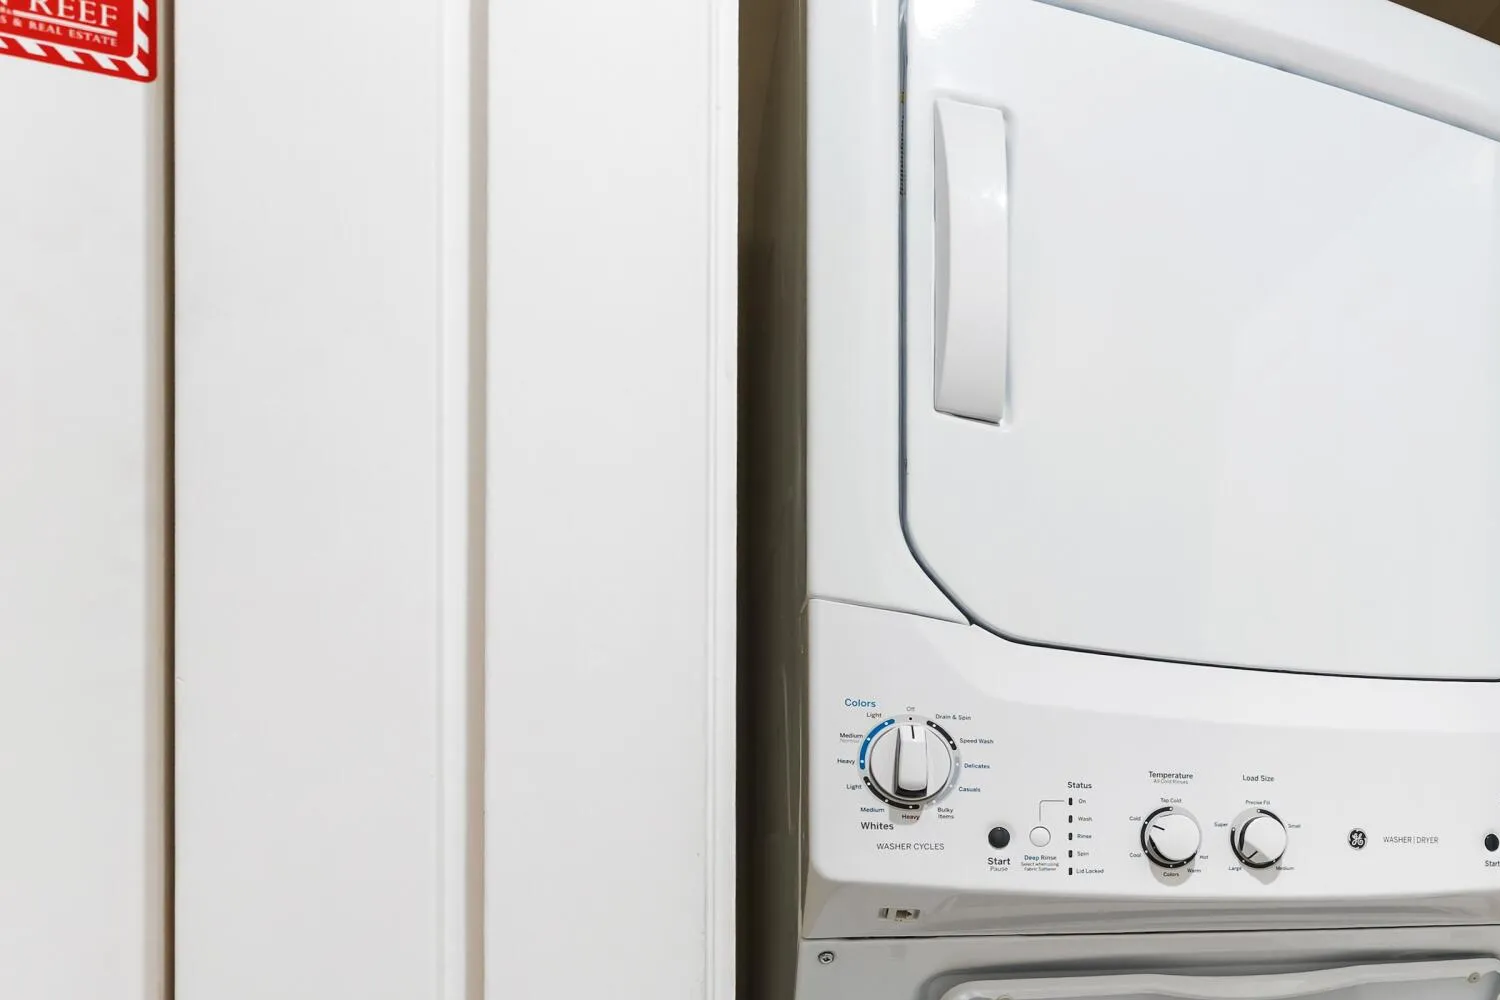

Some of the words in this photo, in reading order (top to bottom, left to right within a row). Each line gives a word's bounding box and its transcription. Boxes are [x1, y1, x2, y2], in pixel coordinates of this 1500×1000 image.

[29, 20, 63, 36] REAL
[69, 29, 118, 47] ESTATE
[844, 698, 876, 708] Colors
[1148, 771, 1194, 780] Temperature
[1242, 774, 1256, 782] Load
[860, 822, 894, 830] Whites
[1383, 836, 1412, 844] WASHER
[988, 858, 1010, 866] Start
